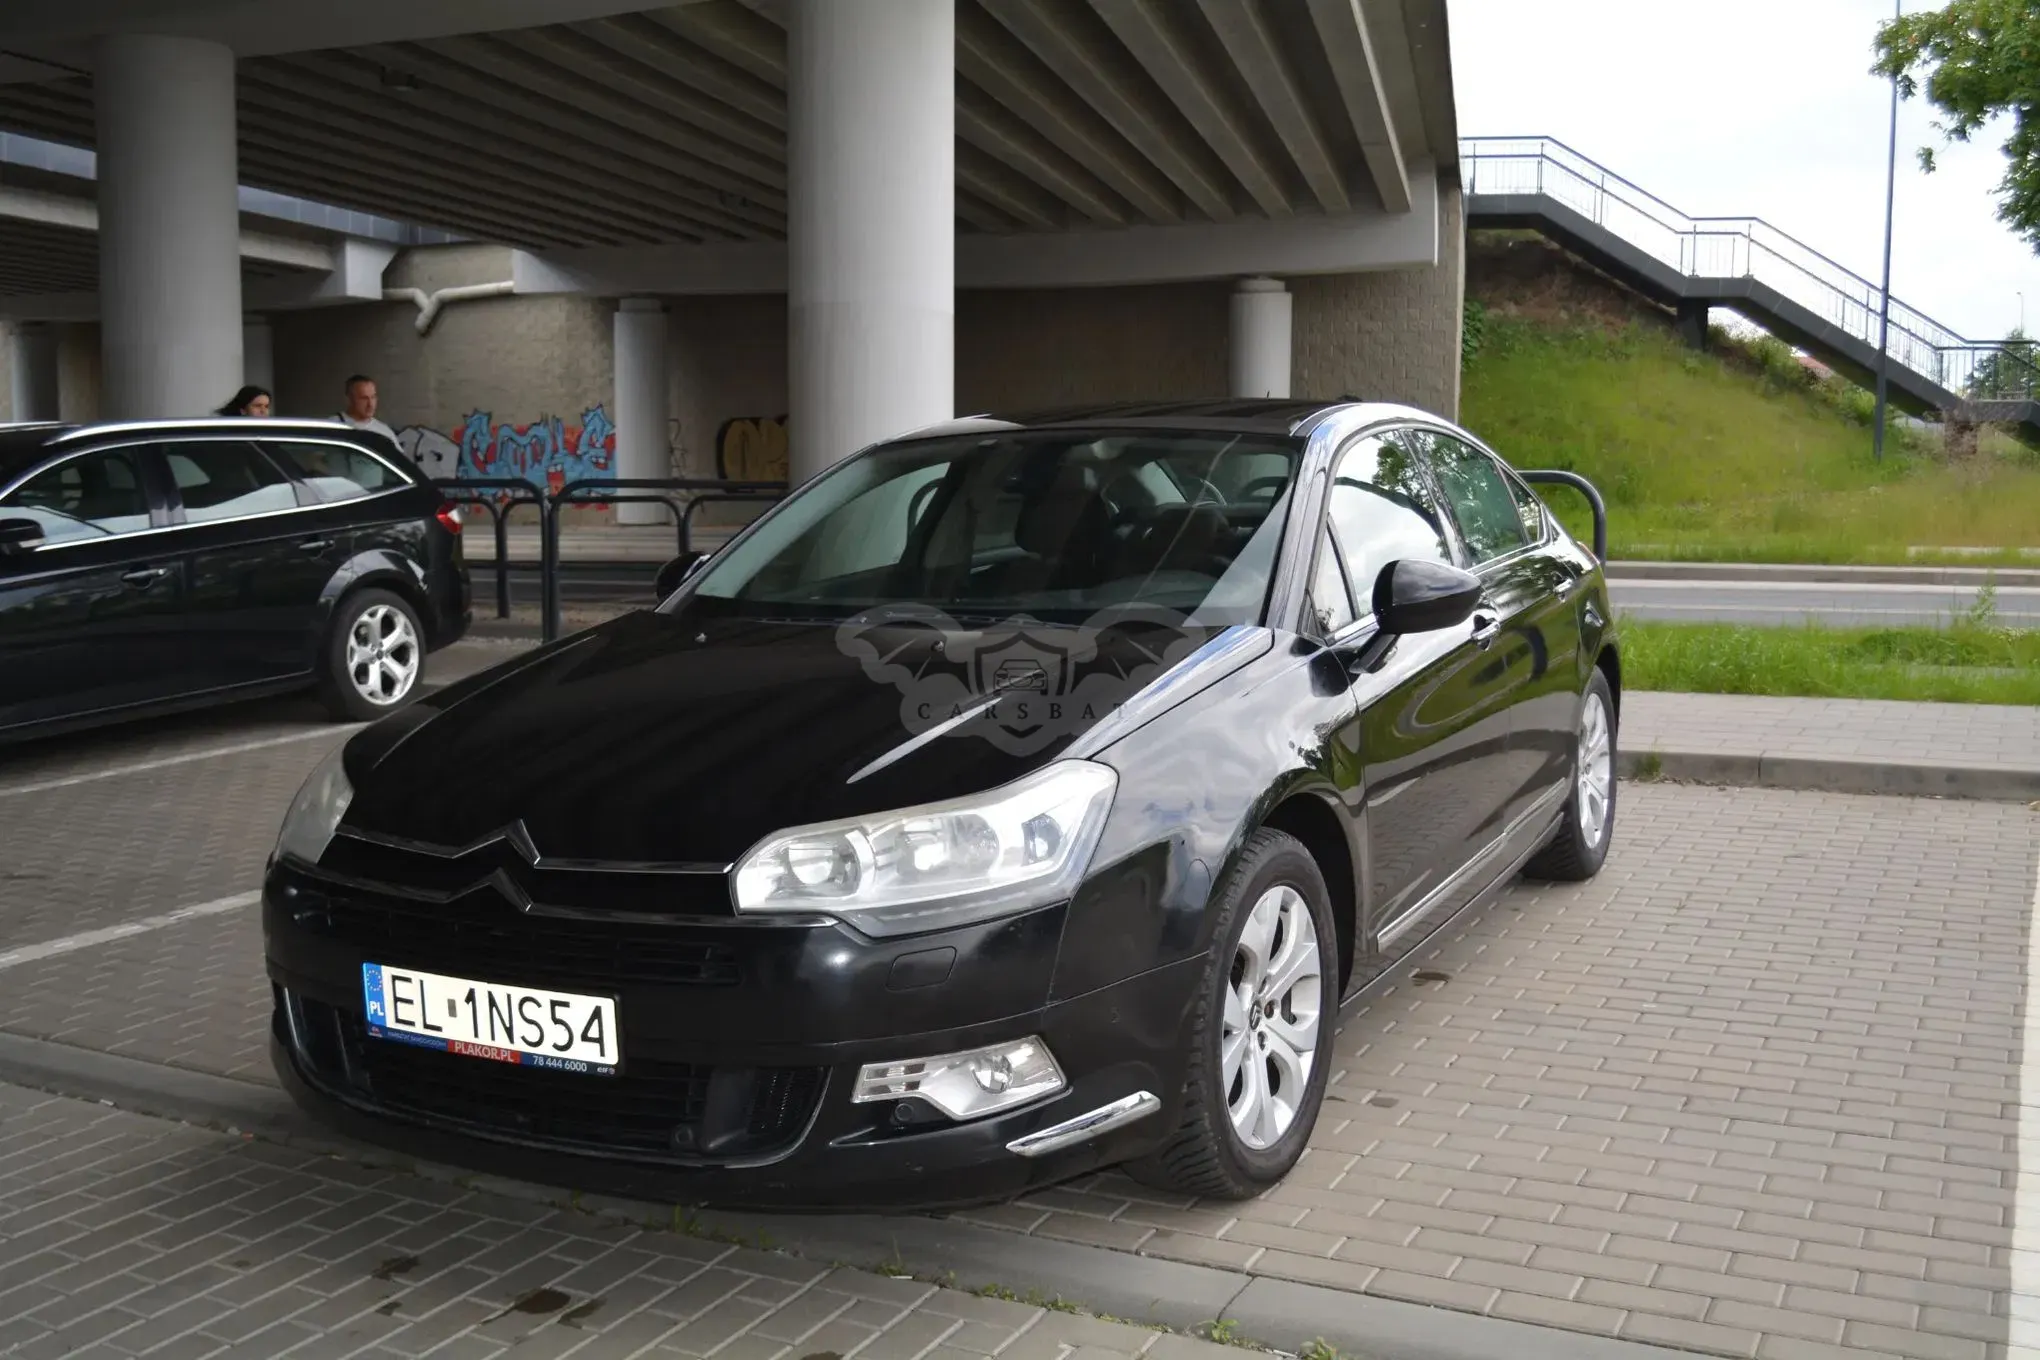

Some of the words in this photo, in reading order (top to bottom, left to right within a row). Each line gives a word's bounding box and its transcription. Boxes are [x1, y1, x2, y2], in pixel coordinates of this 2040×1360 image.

[369, 1000, 384, 1017] PL
[391, 974, 443, 1033] EL
[464, 987, 606, 1058] 1NS54
[454, 1042, 514, 1063] PLAKOR.PL
[533, 1056, 545, 1067] 78
[546, 1057, 562, 1069] 444
[564, 1060, 587, 1072] 6000
